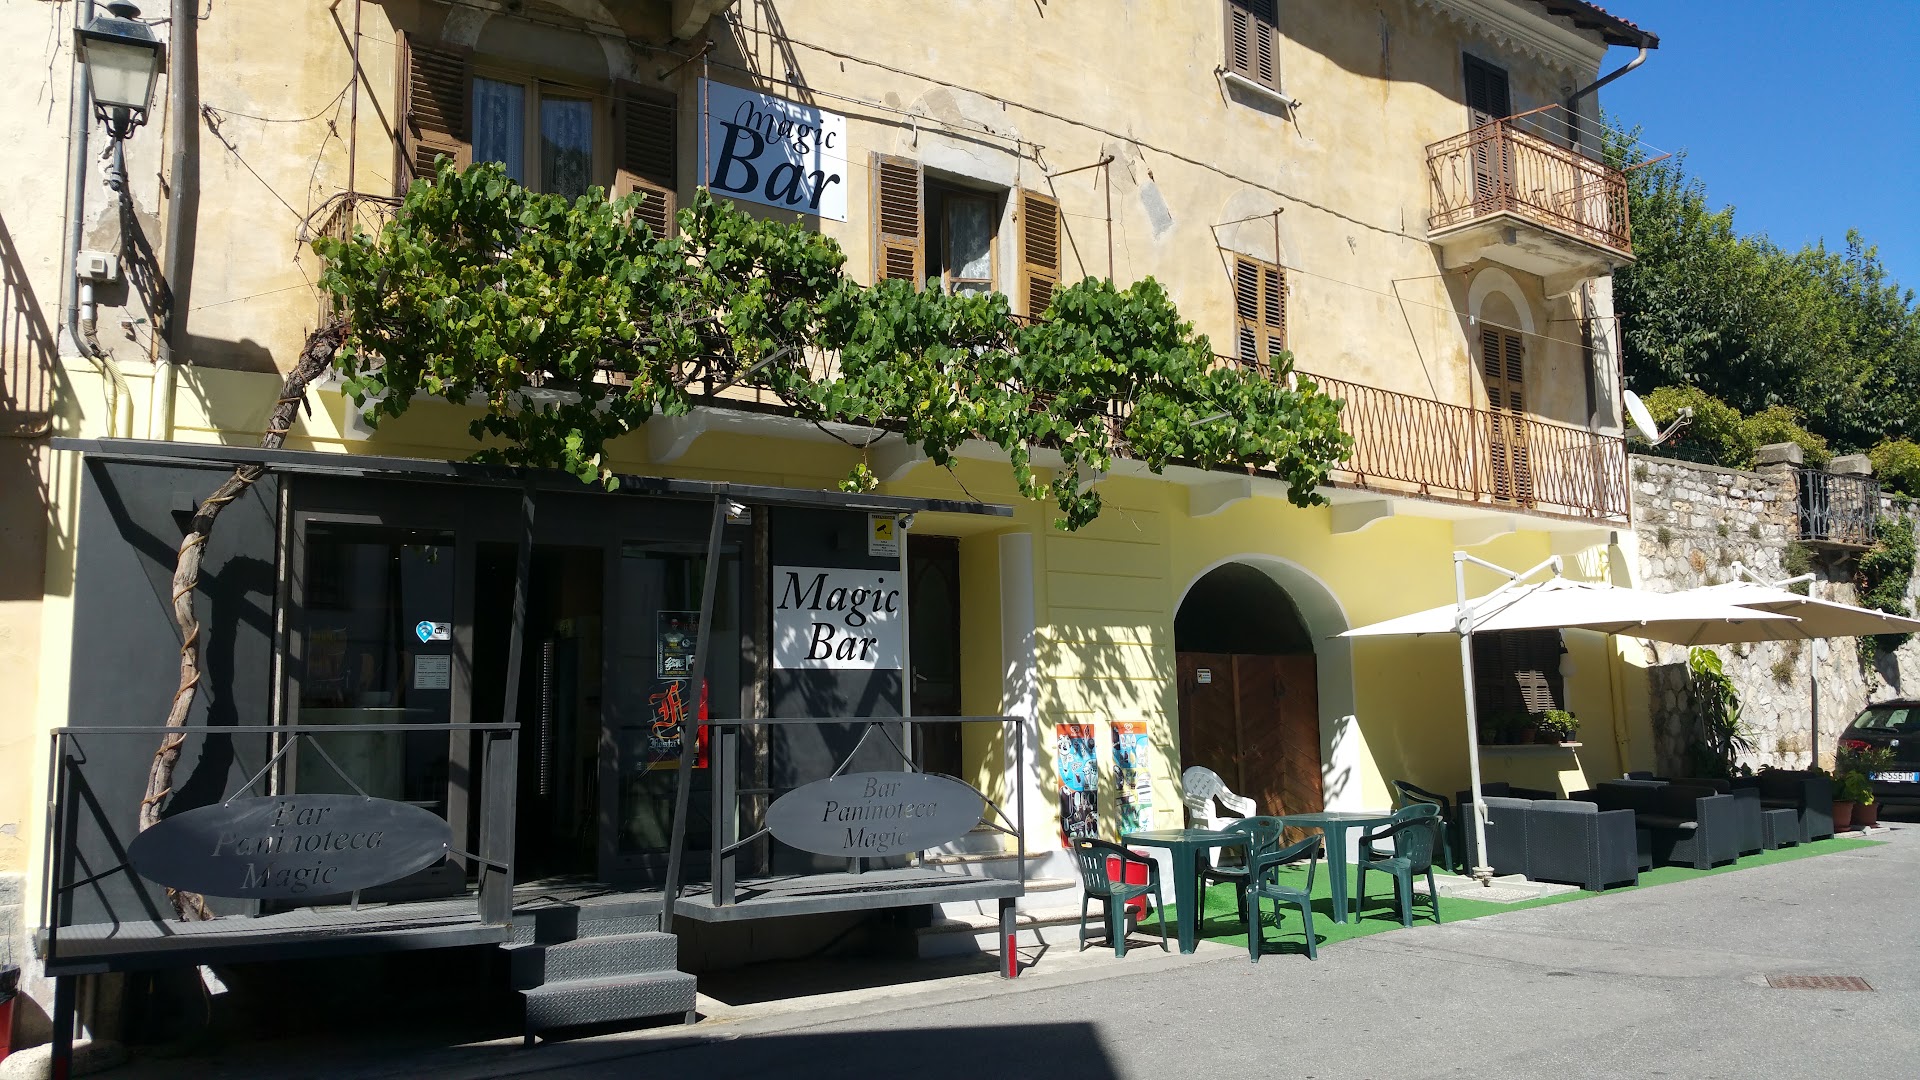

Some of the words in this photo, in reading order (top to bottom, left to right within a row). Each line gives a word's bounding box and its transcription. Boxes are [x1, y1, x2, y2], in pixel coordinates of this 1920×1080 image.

[734, 100, 837, 155] Magic
[709, 121, 841, 210] Bar
[777, 571, 899, 627] Magic
[804, 622, 877, 661] Bar
[862, 777, 901, 798] Bar
[271, 801, 331, 827] Bar
[822, 800, 937, 823] Paninoteca
[843, 827, 908, 852] Magic
[239, 860, 338, 893] Magic
